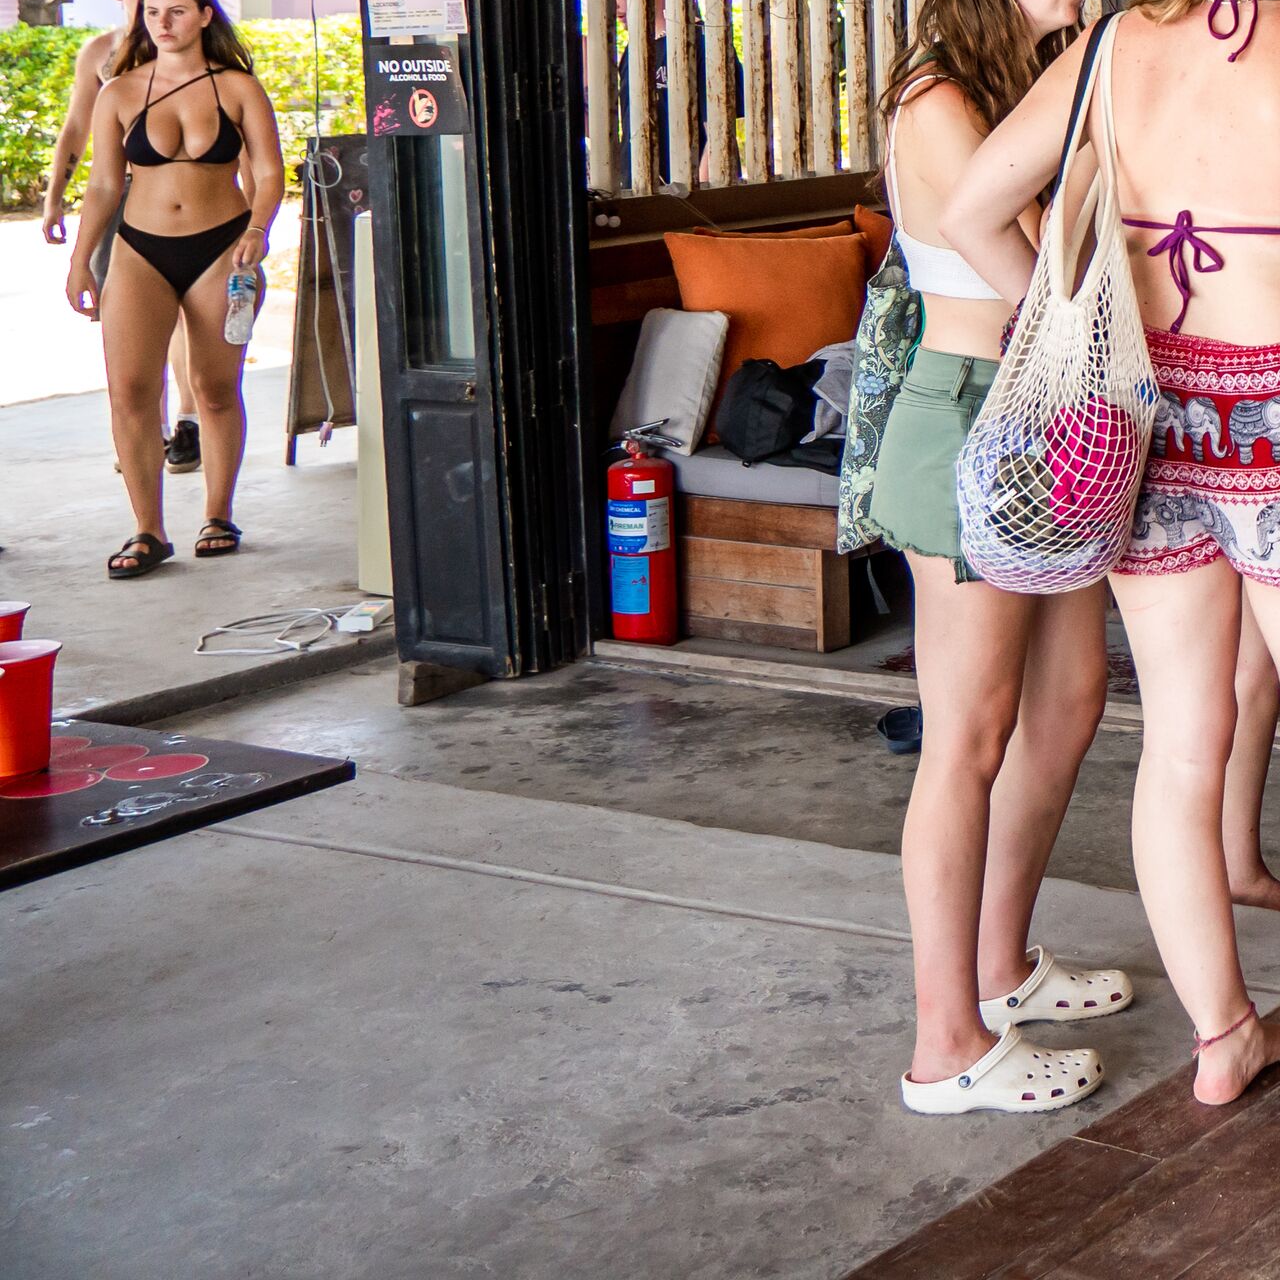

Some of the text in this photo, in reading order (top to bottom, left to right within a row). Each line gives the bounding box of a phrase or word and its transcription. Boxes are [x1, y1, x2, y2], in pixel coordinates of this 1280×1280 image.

[378, 59, 453, 73] NO OUTSIDE
[389, 73, 422, 82] ALCOHOL
[428, 73, 448, 82] FOOD
